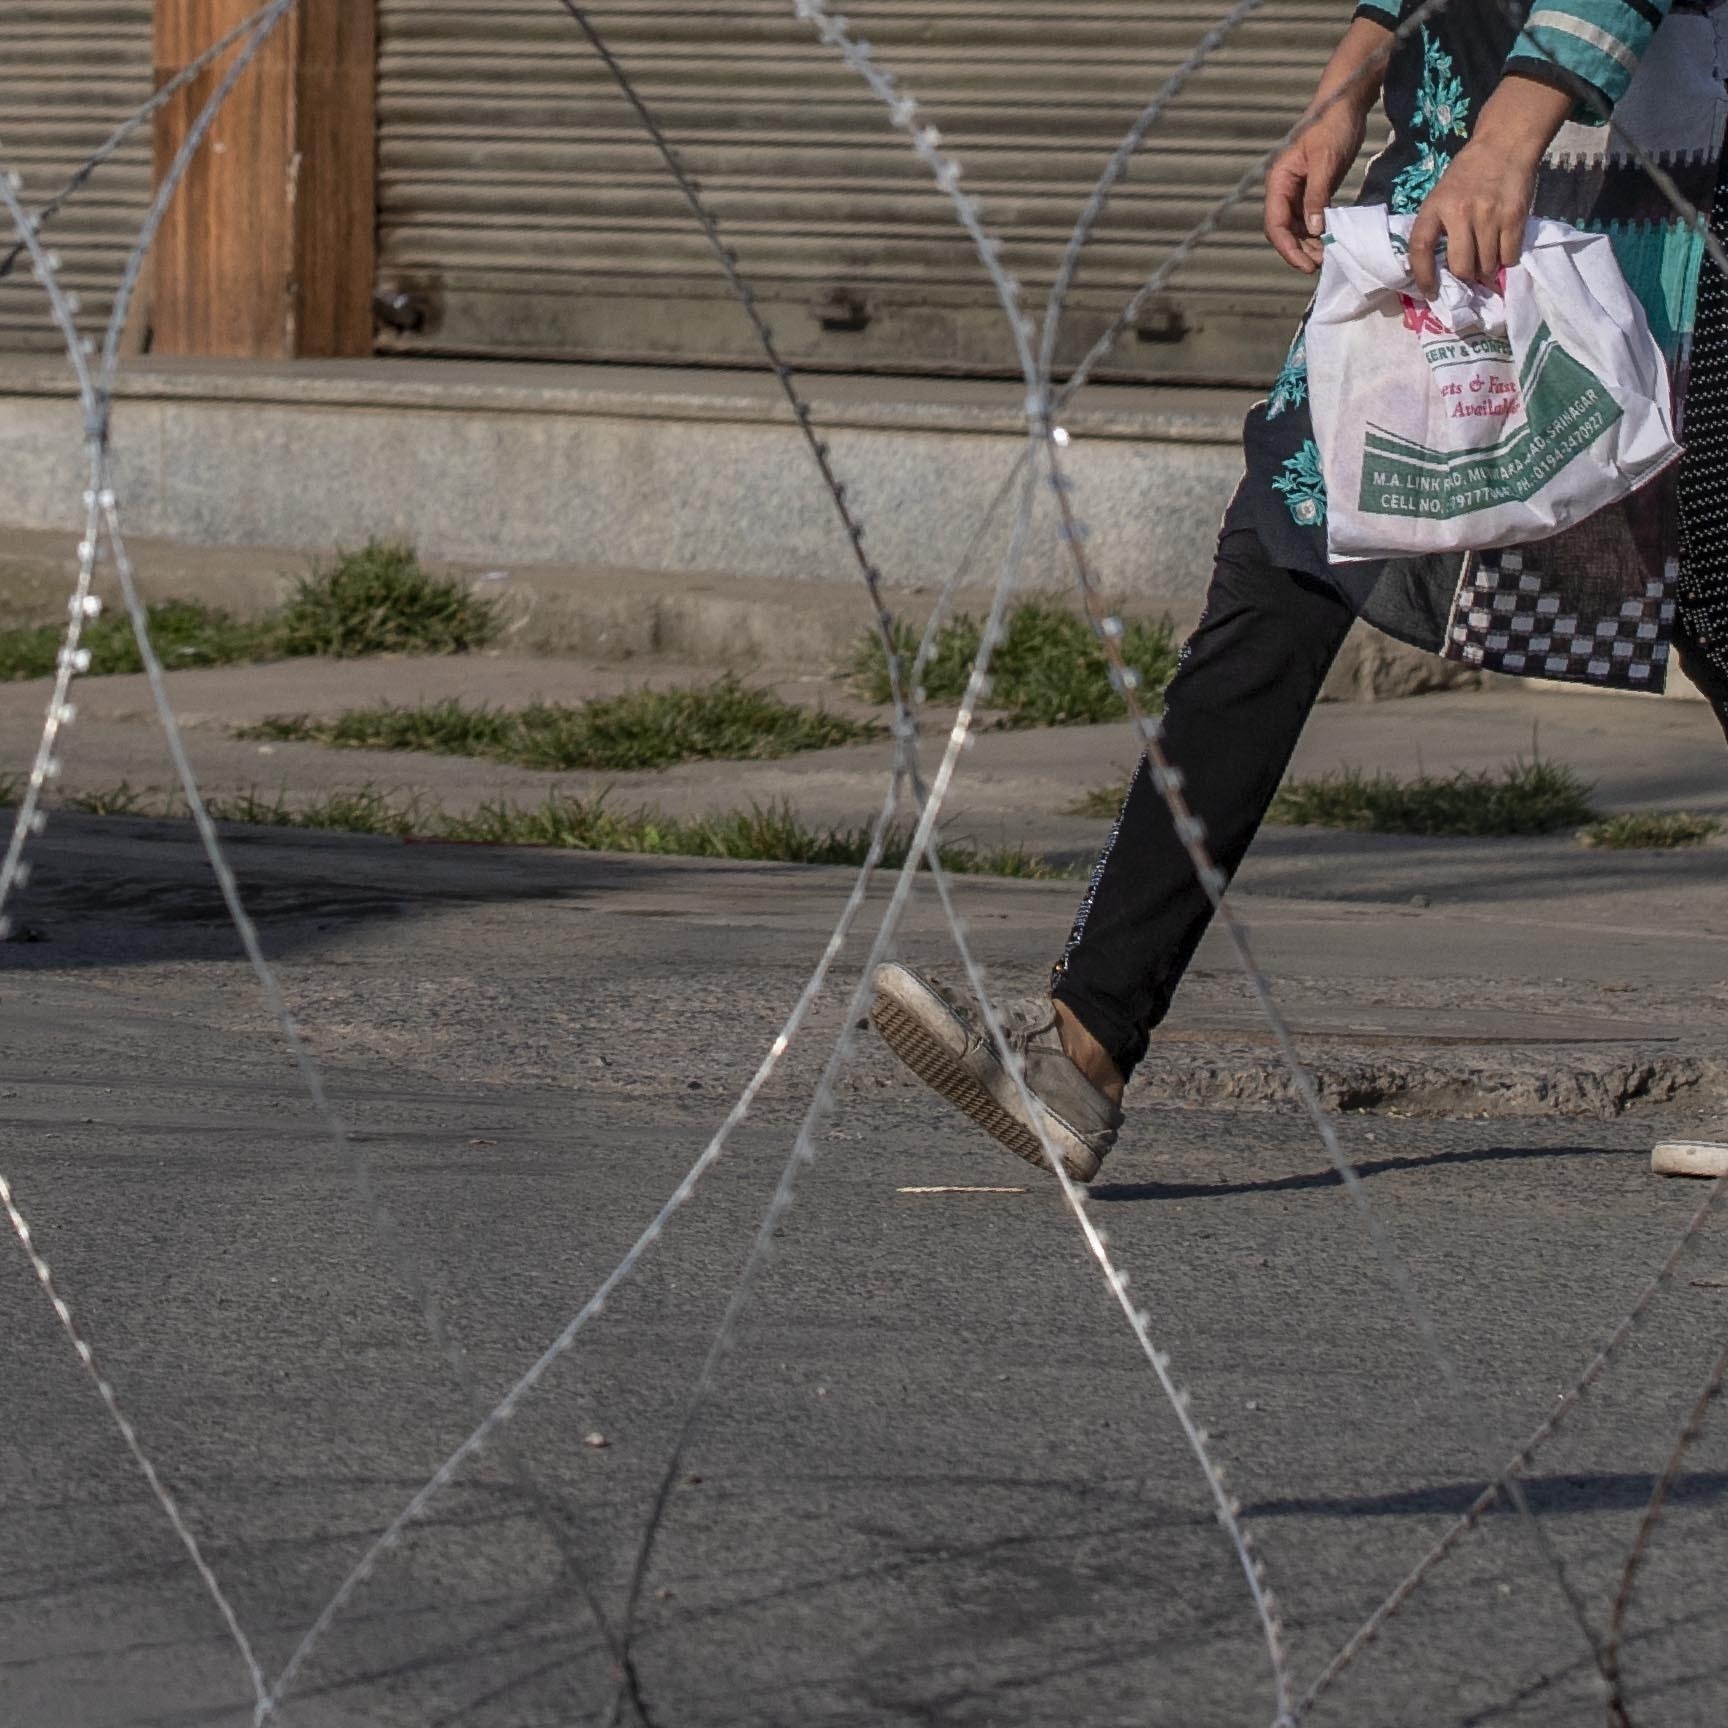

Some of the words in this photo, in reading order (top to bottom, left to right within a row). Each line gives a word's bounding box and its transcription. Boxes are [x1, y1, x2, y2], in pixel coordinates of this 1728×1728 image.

[1406, 474, 1440, 492] LINK
[1545, 388, 1599, 440] SRINAGAR
[1380, 493, 1417, 511] CELL
